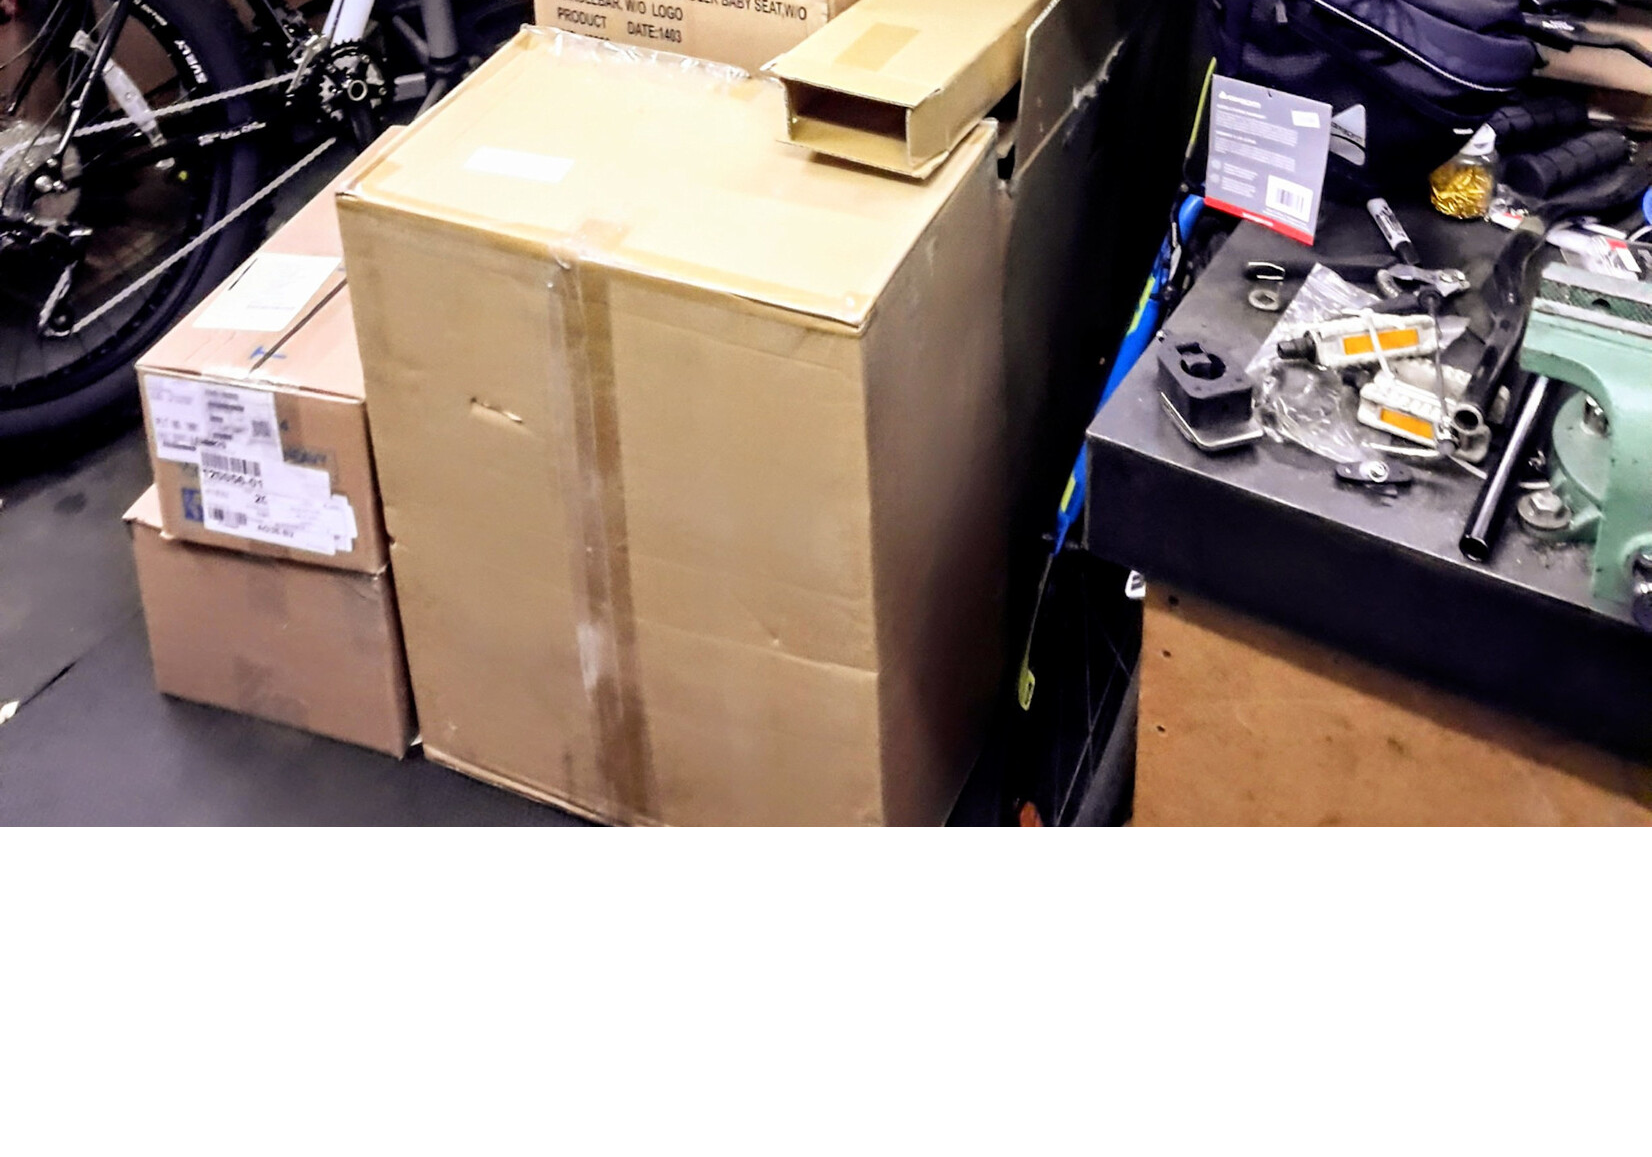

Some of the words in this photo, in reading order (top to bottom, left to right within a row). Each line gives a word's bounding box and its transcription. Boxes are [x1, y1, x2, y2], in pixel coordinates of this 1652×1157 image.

[557, 6, 607, 29] PRODUCT
[626, 20, 683, 44] DATE:1403
[652, 3, 684, 22] LOGO
